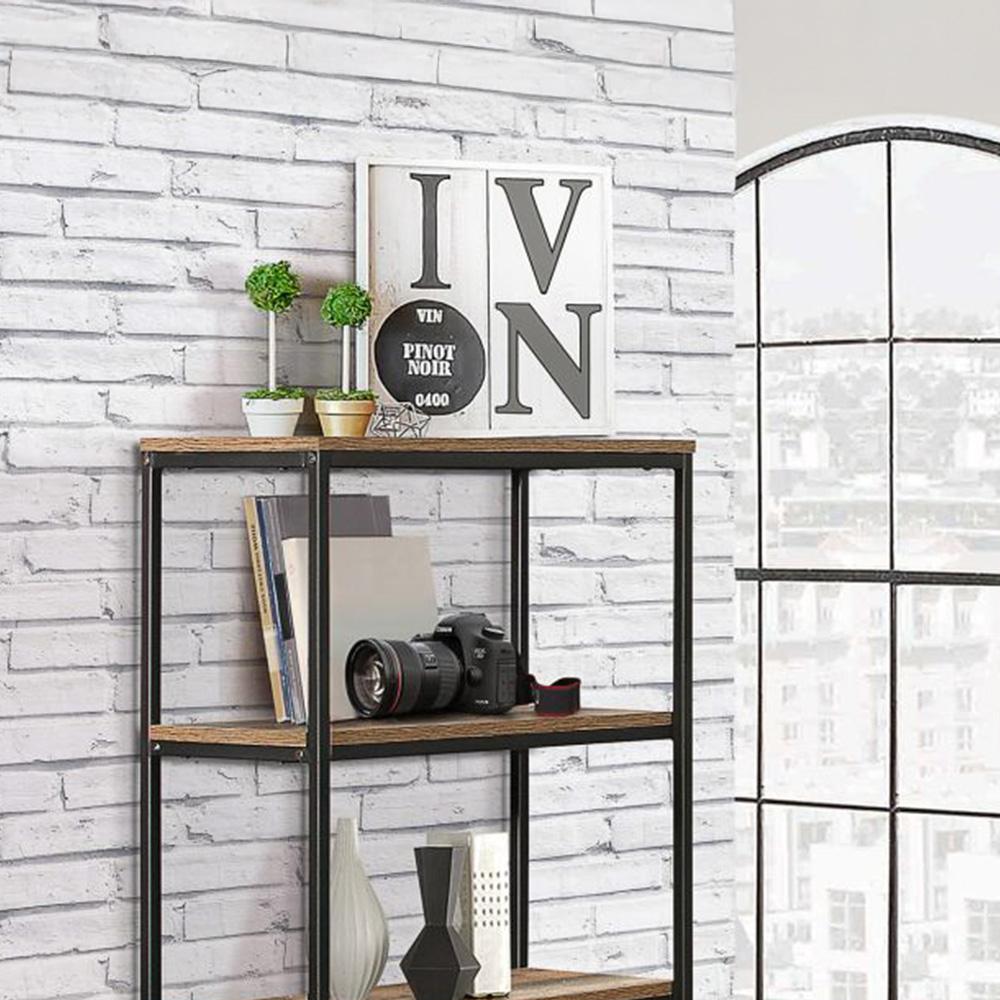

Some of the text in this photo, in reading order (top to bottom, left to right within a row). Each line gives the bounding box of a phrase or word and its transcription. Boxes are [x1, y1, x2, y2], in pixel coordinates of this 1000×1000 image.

[410, 173, 593, 295] I V
[416, 308, 443, 324] VIN
[402, 342, 456, 361] PINOT
[495, 302, 602, 420] N
[407, 359, 452, 377] NOIR
